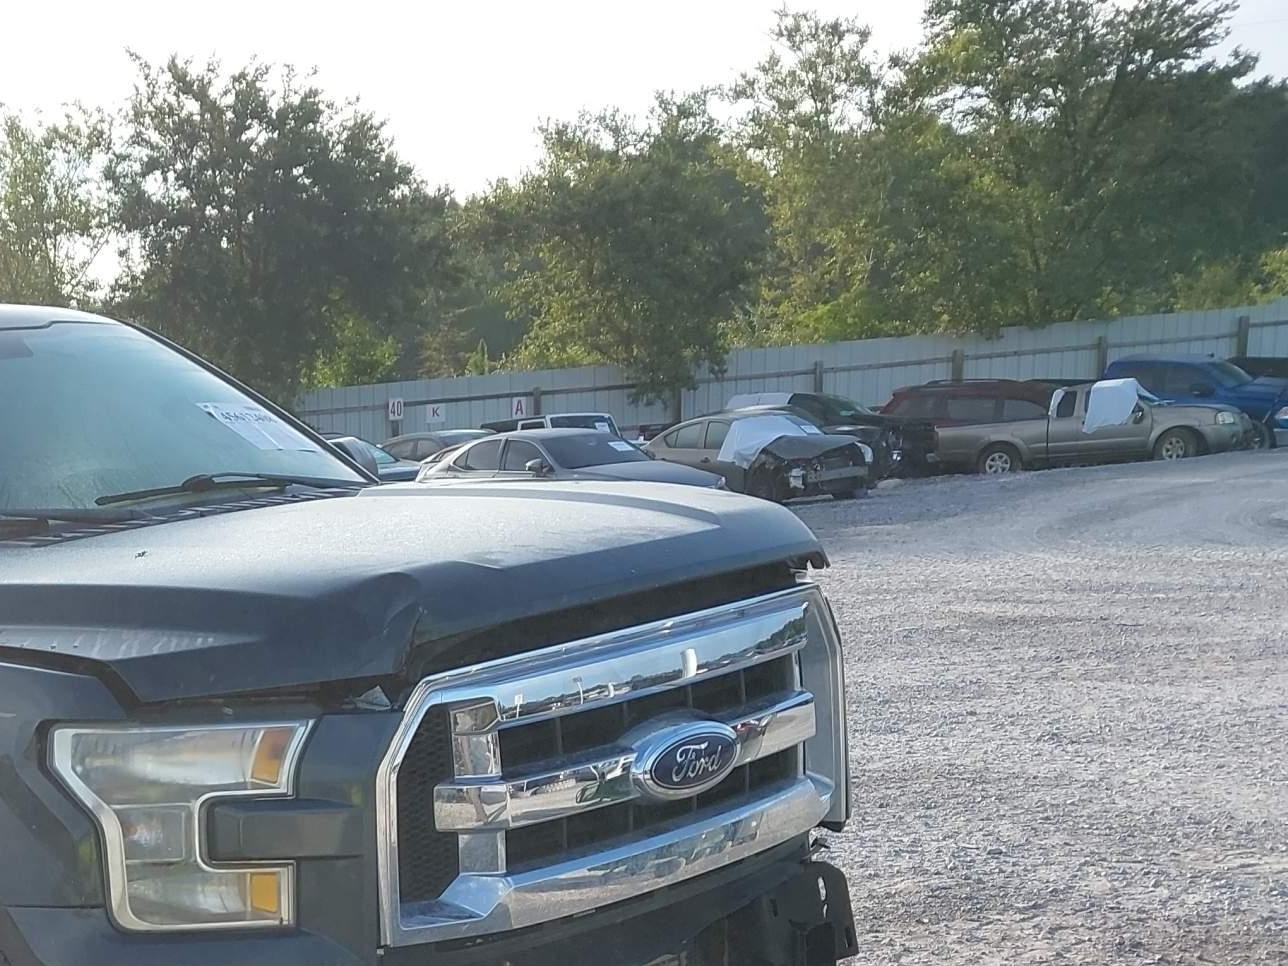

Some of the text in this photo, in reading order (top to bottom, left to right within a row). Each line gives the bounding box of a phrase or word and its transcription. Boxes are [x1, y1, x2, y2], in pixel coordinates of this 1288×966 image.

[390, 400, 402, 417] 40
[432, 407, 440, 417] K
[515, 399, 524, 415] A
[672, 741, 722, 782] Ford
